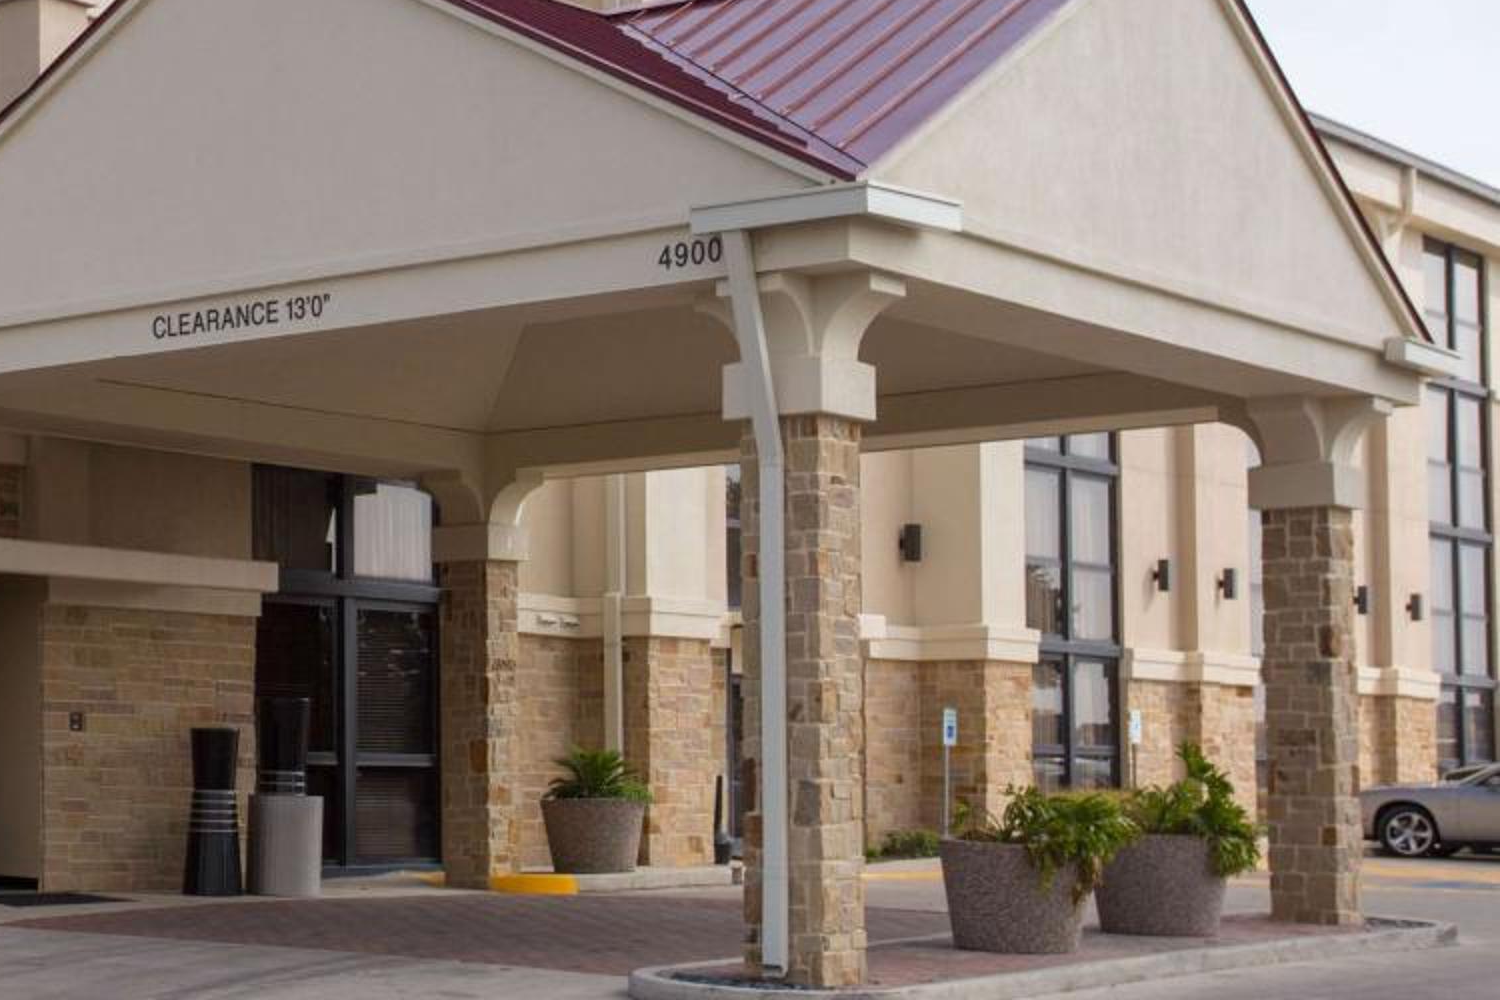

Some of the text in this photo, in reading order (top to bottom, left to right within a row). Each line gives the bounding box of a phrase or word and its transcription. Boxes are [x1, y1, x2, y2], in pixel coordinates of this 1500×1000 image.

[658, 236, 722, 271] 4900
[152, 293, 331, 339] CLEARANCE 13'0"
